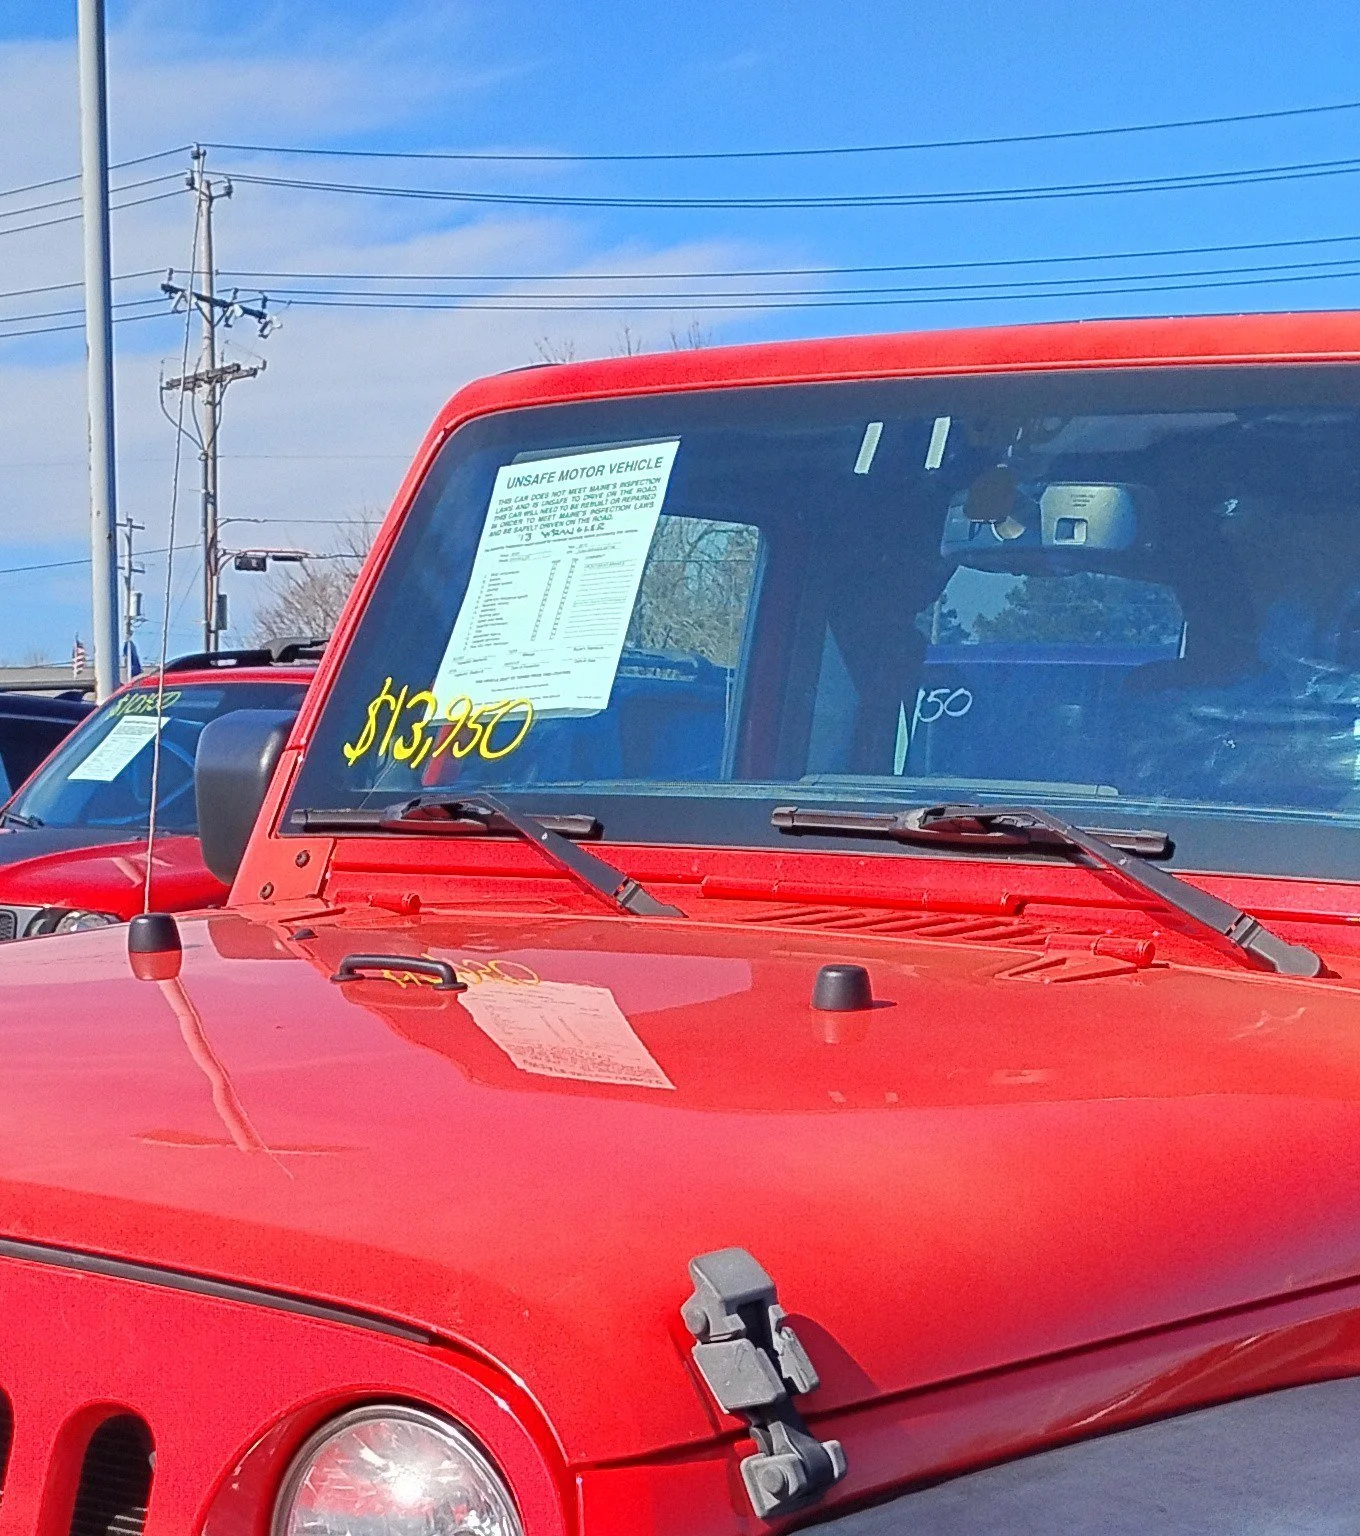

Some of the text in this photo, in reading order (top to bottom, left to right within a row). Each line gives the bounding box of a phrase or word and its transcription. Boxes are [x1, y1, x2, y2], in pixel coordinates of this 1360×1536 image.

[506, 456, 663, 489] UNSAFE MOTOR VEHICLE
[344, 677, 534, 768] $13,950
